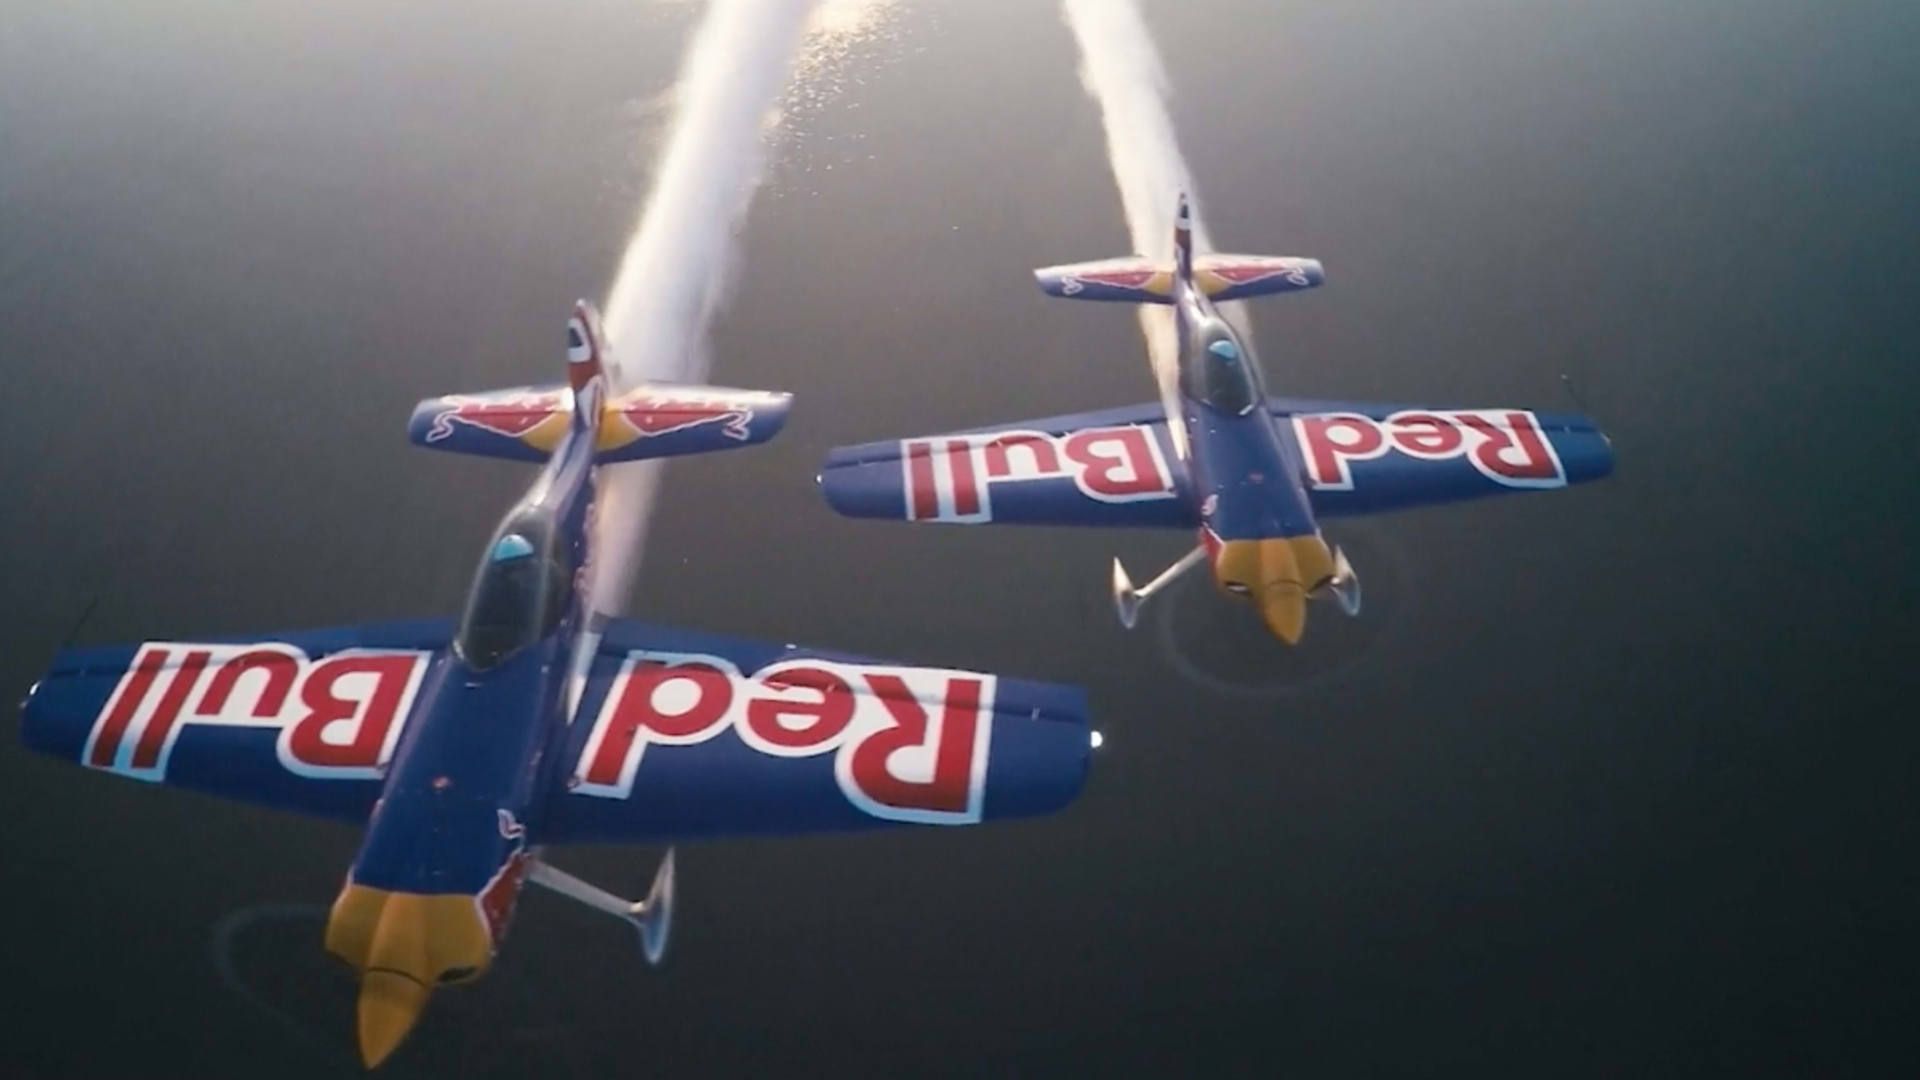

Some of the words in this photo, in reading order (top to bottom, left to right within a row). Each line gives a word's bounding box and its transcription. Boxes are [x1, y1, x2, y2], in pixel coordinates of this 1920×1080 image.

[904, 429, 1174, 521] Bull
[1293, 409, 1567, 489] Red
[84, 643, 430, 781] Bull
[571, 651, 996, 823] Red
